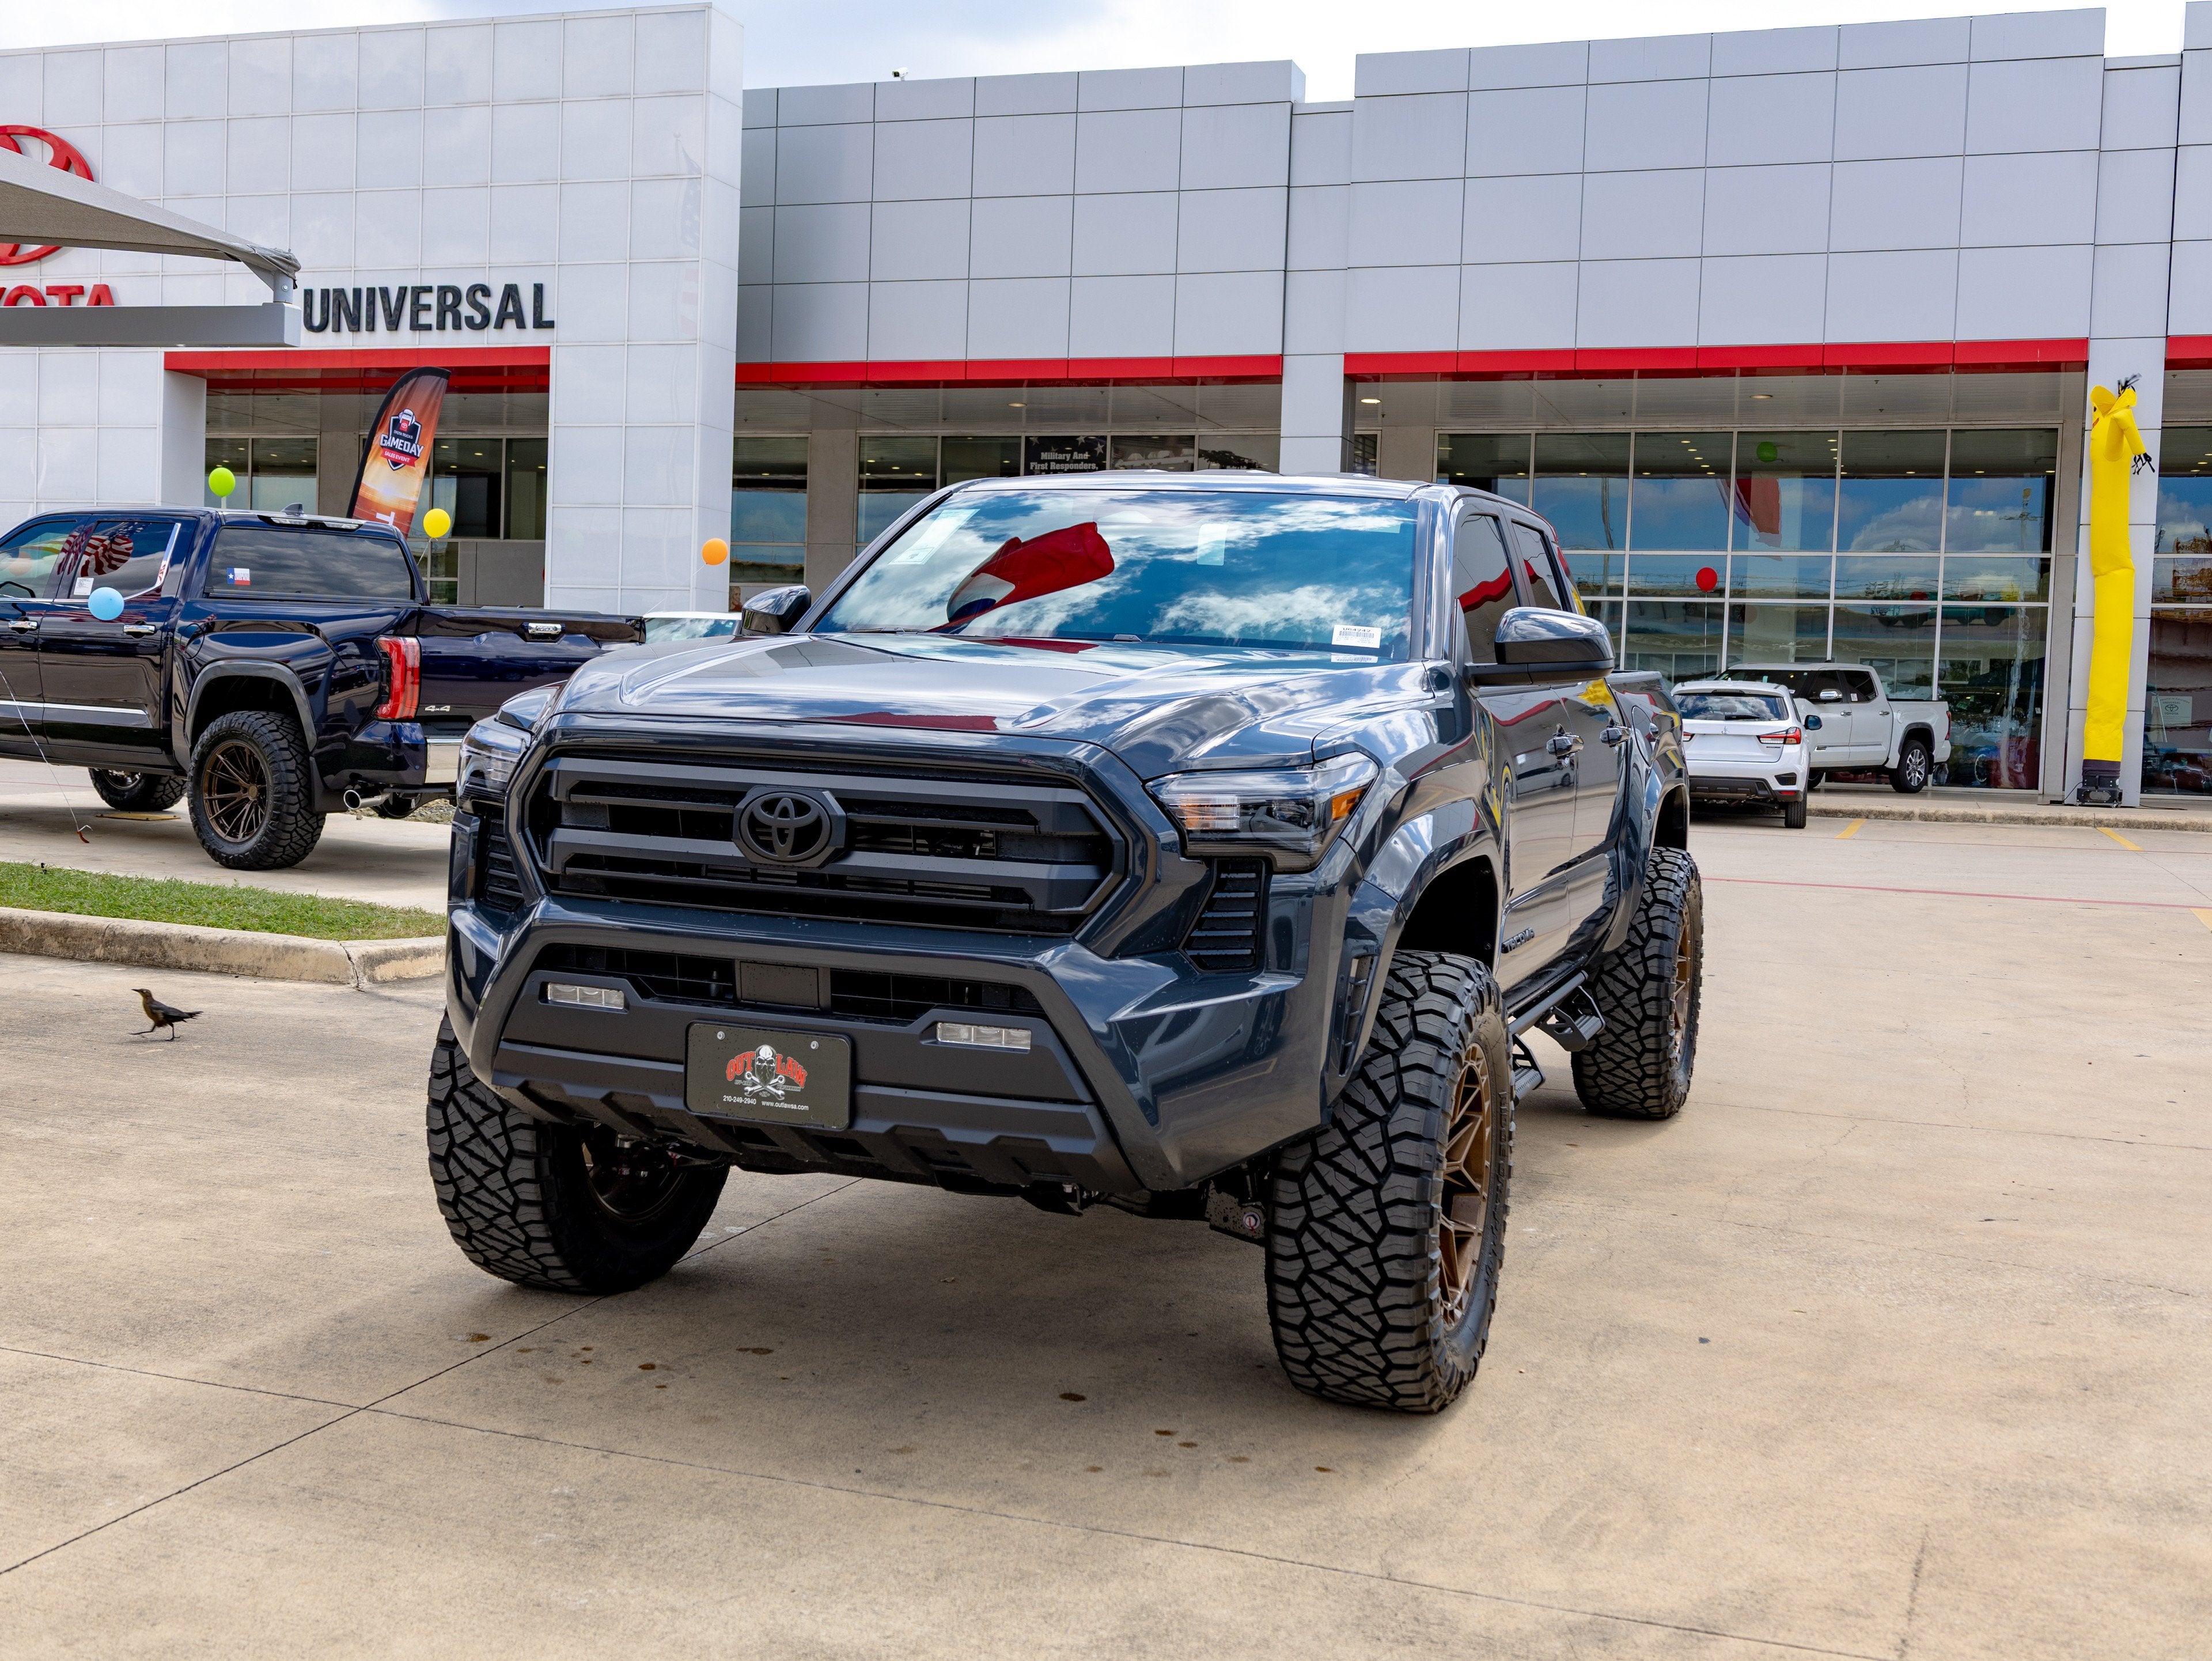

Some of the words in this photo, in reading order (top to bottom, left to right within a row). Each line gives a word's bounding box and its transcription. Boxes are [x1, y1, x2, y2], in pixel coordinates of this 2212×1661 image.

[303, 283, 555, 332] UNIVERSAL
[380, 434, 425, 457] GAMEDAY
[384, 451, 396, 459] SALES
[396, 455, 410, 463] EVENT
[1040, 452, 1071, 461] Military
[1073, 452, 1089, 460] And
[1030, 461, 1048, 470] First
[1050, 461, 1099, 471] Responders,
[723, 1095, 757, 1105] 210-249-2940
[762, 1100, 809, 1111] www.outlawsa.com
